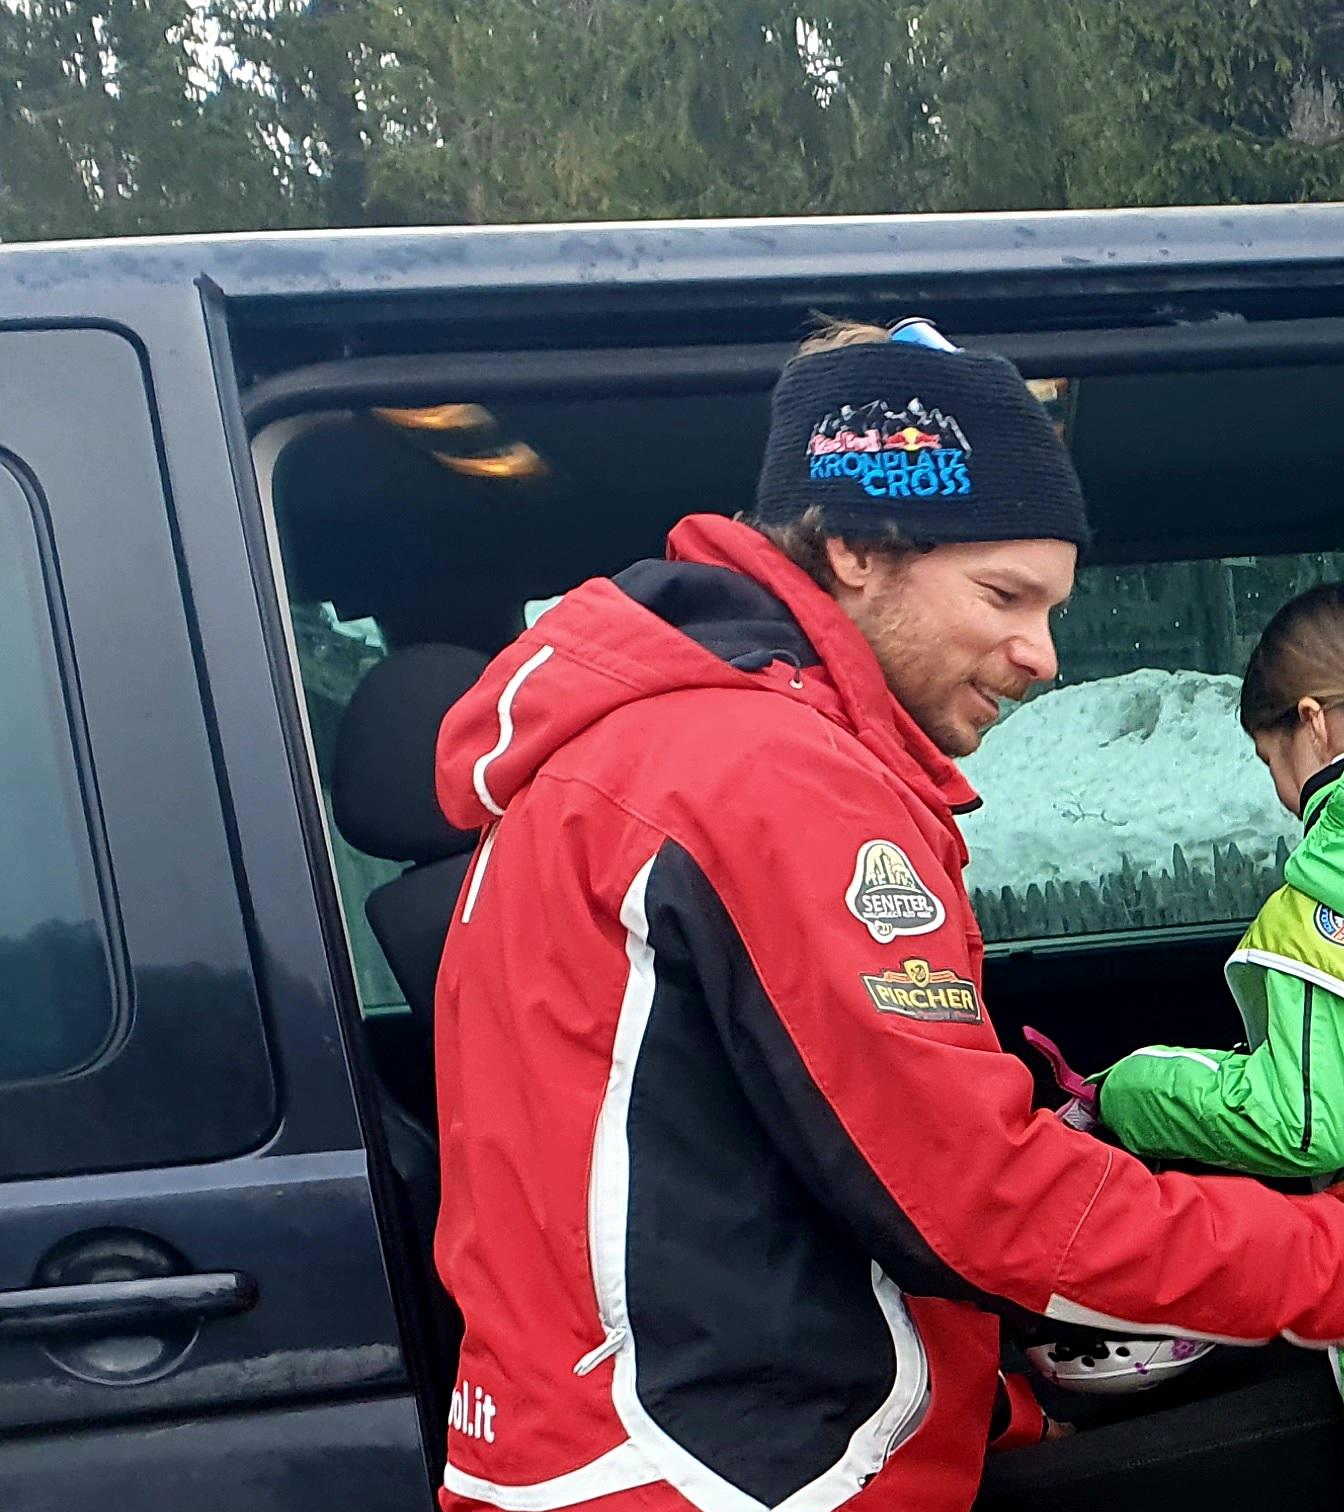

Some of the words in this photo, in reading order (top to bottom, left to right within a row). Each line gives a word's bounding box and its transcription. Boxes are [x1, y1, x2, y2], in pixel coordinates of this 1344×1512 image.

[810, 449, 965, 478] KRONPLATZ
[862, 467, 972, 497] CROSS
[862, 894, 934, 916] SENFTER
[875, 984, 975, 1010] PIRCHER
